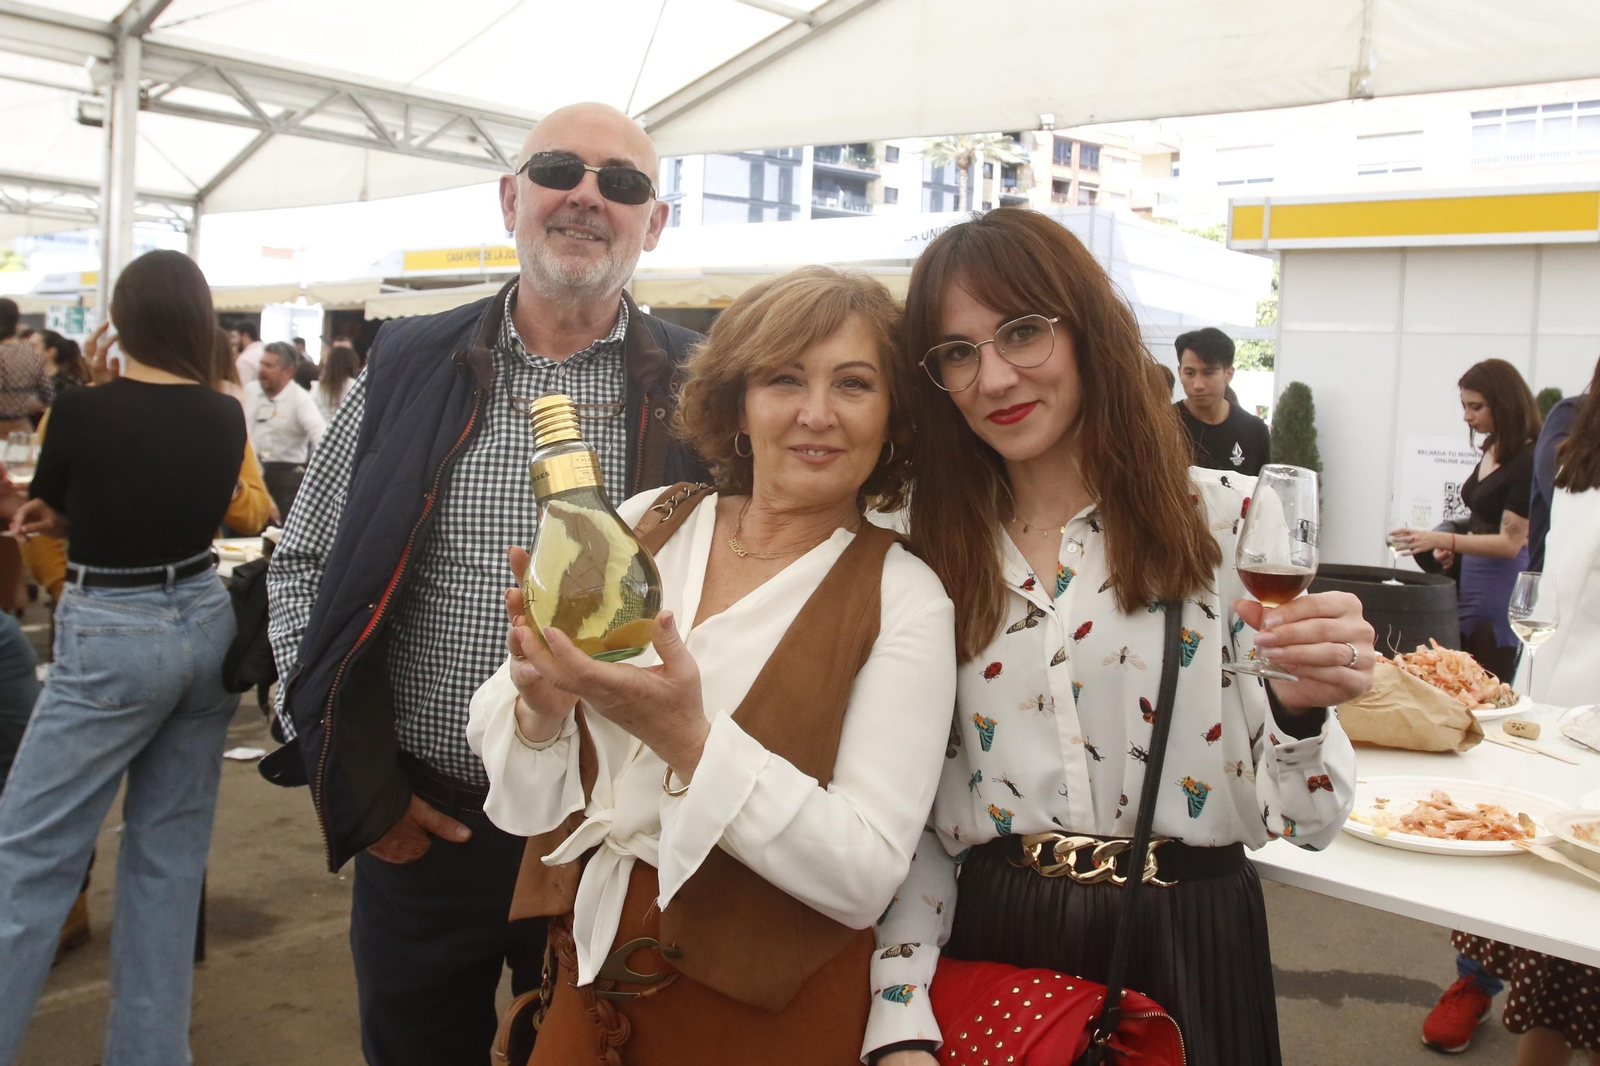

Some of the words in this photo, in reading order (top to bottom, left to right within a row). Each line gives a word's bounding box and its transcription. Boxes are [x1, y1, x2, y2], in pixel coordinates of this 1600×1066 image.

[446, 251, 463, 262] CASA
[464, 250, 481, 261] PEPE
[494, 249, 503, 260] LA
